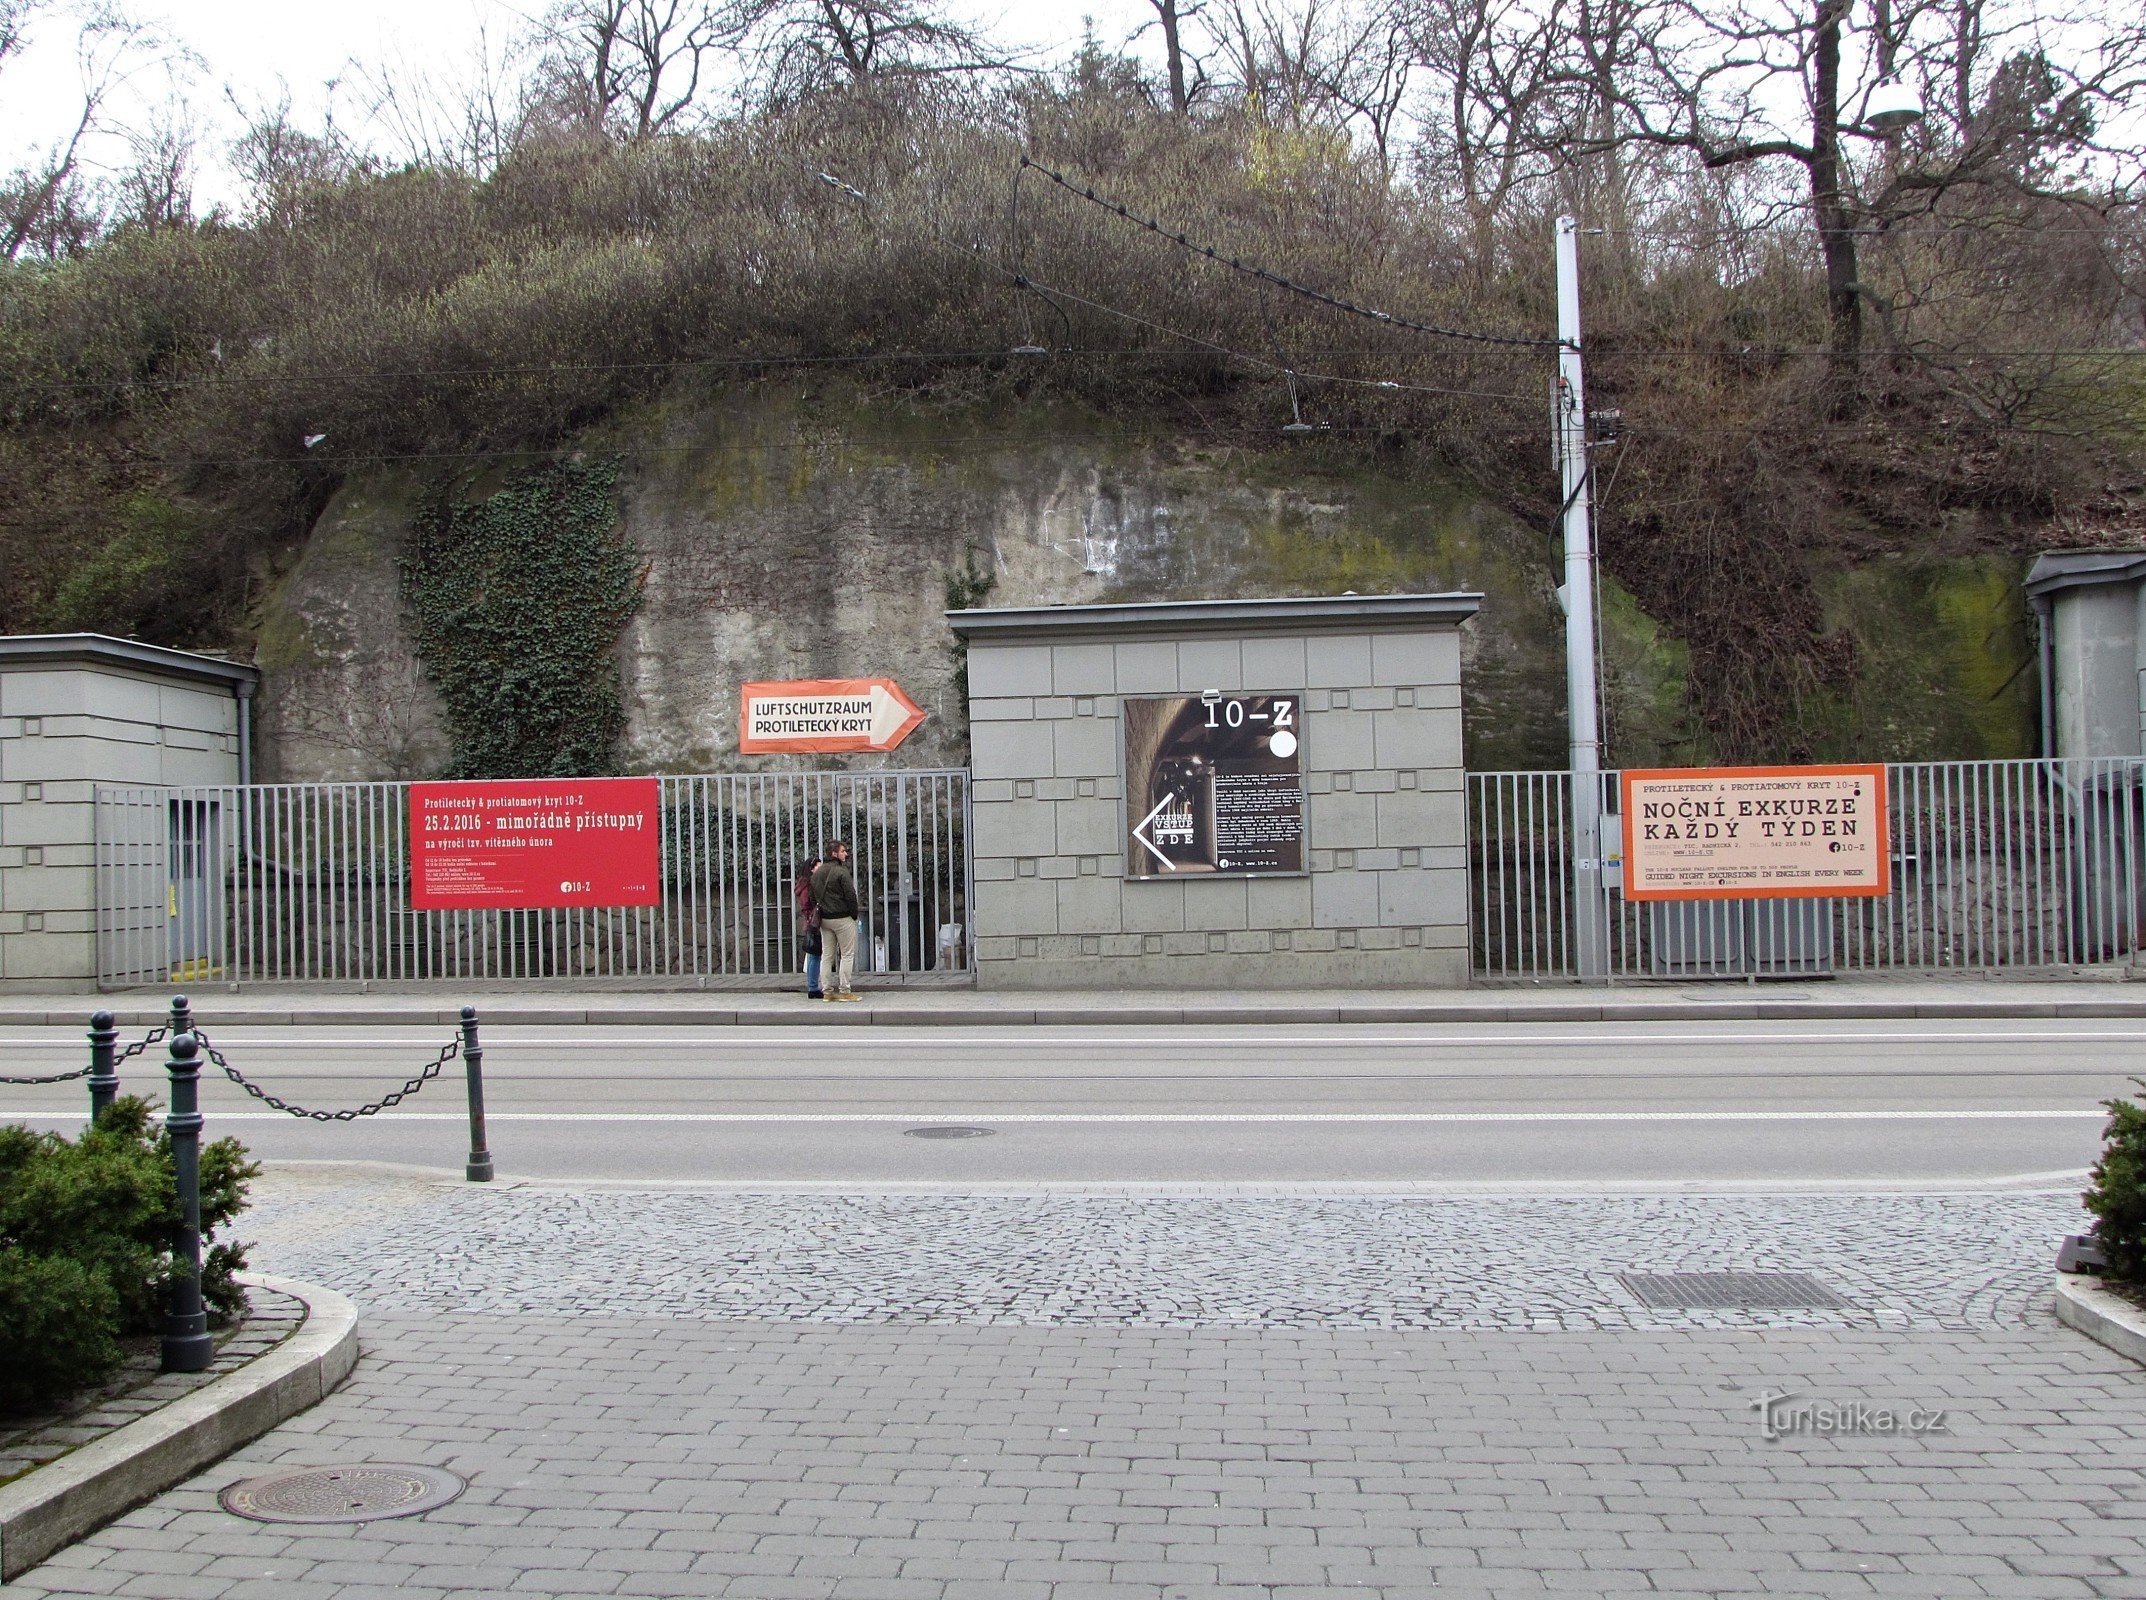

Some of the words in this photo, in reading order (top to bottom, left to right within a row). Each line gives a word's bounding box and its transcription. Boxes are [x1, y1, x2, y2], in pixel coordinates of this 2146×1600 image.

[756, 701, 872, 716] LUFTSCHUTZRAUM
[1203, 700, 1293, 728] 10-Z
[756, 718, 839, 733] PROTILETECKÝ
[842, 719, 872, 732] KRYT
[1643, 782, 1714, 793] PROTILETECKÝ
[1731, 781, 1802, 791] PROTIATOMOVÝ
[1836, 781, 1860, 790] 10-Z
[425, 798, 476, 809] Protiletecký
[478, 797, 484, 807] &
[487, 796, 542, 808] protiatomový
[545, 796, 562, 807] kryt
[565, 795, 583, 806] 10-Z
[1643, 796, 1725, 818] NOČNÍ
[1738, 798, 1856, 817] EXKURZE
[425, 814, 481, 831] 25.2.2016
[496, 812, 571, 829] mimořádně
[576, 811, 644, 832] přístupný
[1155, 820, 1193, 829] VSTUP
[1643, 817, 1740, 840] KAŽDÝ
[1761, 816, 1857, 837] TÝDEN
[425, 840, 436, 849] na
[438, 837, 464, 851] výročí
[467, 838, 483, 849] tzv.
[485, 836, 526, 848] vítězného
[529, 836, 553, 847] února
[1679, 872, 1704, 880] NIGHT
[1708, 871, 1757, 879] EXCURSIONS
[1776, 870, 1811, 878] ENGLISH
[573, 881, 591, 892] 10-Z
